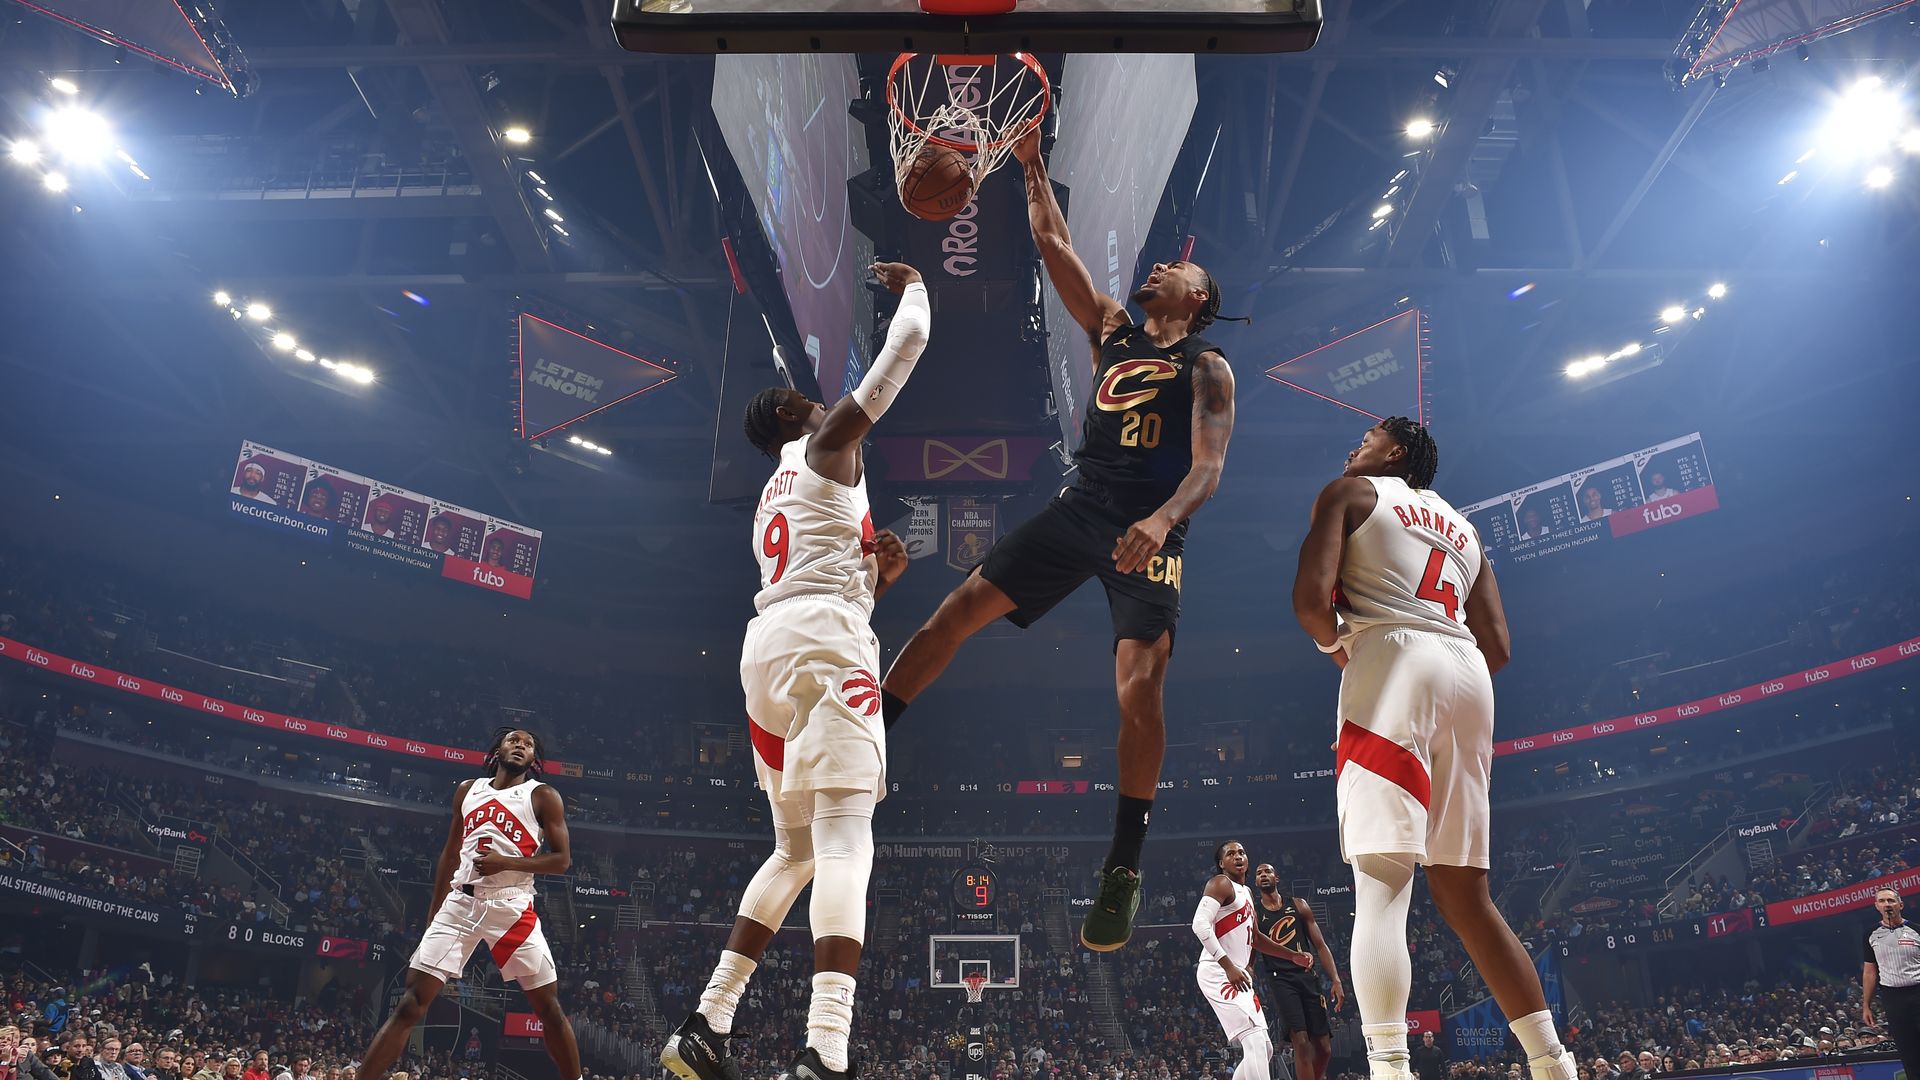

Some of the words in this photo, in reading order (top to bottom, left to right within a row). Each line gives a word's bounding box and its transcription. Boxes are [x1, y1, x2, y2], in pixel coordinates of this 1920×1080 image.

[1327, 359, 1363, 383] LET
[1364, 348, 1394, 366] EM
[534, 358, 570, 379] LET
[574, 371, 604, 390] EM
[1333, 359, 1404, 395] KNOW.
[528, 370, 599, 404] KNOW.
[1096, 359, 1178, 412] C
[1120, 410, 1162, 449] 20
[231, 499, 329, 536] WeCutCarbon.com
[964, 511, 979, 519] NBA
[1642, 503, 1682, 524] fubo
[951, 519, 992, 528] CHAMPIONS
[1393, 504, 1469, 551] BARNES
[347, 529, 375, 543] BARNES
[391, 541, 412, 554] THREE
[413, 547, 439, 560] DAYLON
[1510, 541, 1535, 553] BARNES
[1552, 530, 1573, 540] THREE
[1574, 522, 1602, 534] DAYLON
[347, 541, 370, 554] TYSON
[372, 548, 405, 562] BRANDON
[405, 557, 432, 569] INGRAM
[763, 512, 789, 585] 9
[1514, 552, 1536, 564] TYSON
[1538, 542, 1571, 557] BRANDON
[1571, 534, 1599, 547] INGRAM
[472, 566, 505, 587] fubo
[1415, 547, 1459, 623] 4
[26, 649, 48, 666] fubo
[1850, 655, 1877, 671] fubo
[71, 664, 95, 679] fubo
[1804, 669, 1830, 684] fubo
[117, 675, 140, 691] fubo
[1760, 681, 1785, 695] fubo
[161, 688, 183, 702] fubo
[1719, 694, 1742, 707] fubo
[202, 699, 224, 713] fubo
[1677, 704, 1700, 718] fubo
[243, 709, 265, 723] fubo
[1633, 713, 1657, 726] fubo
[284, 718, 307, 732] fubo
[1592, 723, 1615, 735] fubo
[326, 726, 348, 739] fubo
[1552, 730, 1574, 743] fubo
[367, 734, 388, 747] fubo
[1513, 738, 1535, 751] fubo
[405, 742, 426, 754] fubo
[444, 749, 465, 761] fubo
[1246, 774, 1264, 783] 7:46
[1265, 773, 1278, 782] PM
[1293, 770, 1315, 779] LET
[1316, 769, 1333, 778] EM
[709, 778, 727, 787] TOL
[734, 779, 740, 788] 7
[892, 783, 900, 792] 8
[960, 783, 978, 792] 8:14
[997, 782, 1012, 793] 1Q
[1035, 782, 1048, 792] 11
[1094, 783, 1114, 792] FG%
[1182, 779, 1189, 788] 2
[1201, 778, 1219, 787] TOL
[1227, 776, 1233, 785] 7
[147, 824, 187, 840] KeyBank
[1738, 822, 1778, 838] KeyBank
[966, 875, 989, 886] 8:14
[575, 886, 609, 897] KeyBank
[976, 886, 988, 906] 9
[1316, 884, 1350, 895] KeyBank
[14, 880, 65, 901] STREAMING
[66, 893, 102, 911] PARTNER
[103, 902, 115, 913] OF
[117, 905, 133, 918] THE
[134, 909, 159, 923] CAVS
[1791, 899, 1827, 916] WATCH
[1828, 893, 1851, 908] CAVS
[1852, 886, 1879, 902] GAMES
[184, 913, 198, 922] FG%
[1758, 916, 1766, 928] 2
[184, 924, 194, 935] 33
[1693, 924, 1700, 935] 9
[1711, 918, 1727, 934] 11
[228, 925, 237, 940] 8
[244, 928, 253, 942] 0
[262, 931, 304, 949] BLOCKS
[1606, 935, 1616, 949] 8
[1623, 934, 1636, 944] 1Q
[1652, 928, 1675, 943] 8:14
[321, 939, 331, 954] 0
[373, 942, 386, 952] FG%
[1562, 947, 1569, 957] 0
[372, 951, 381, 961] 71
[1455, 1026, 1504, 1037] COMCAST
[1456, 1036, 1505, 1047] BUSINESS
[970, 1048, 983, 1058] ups
